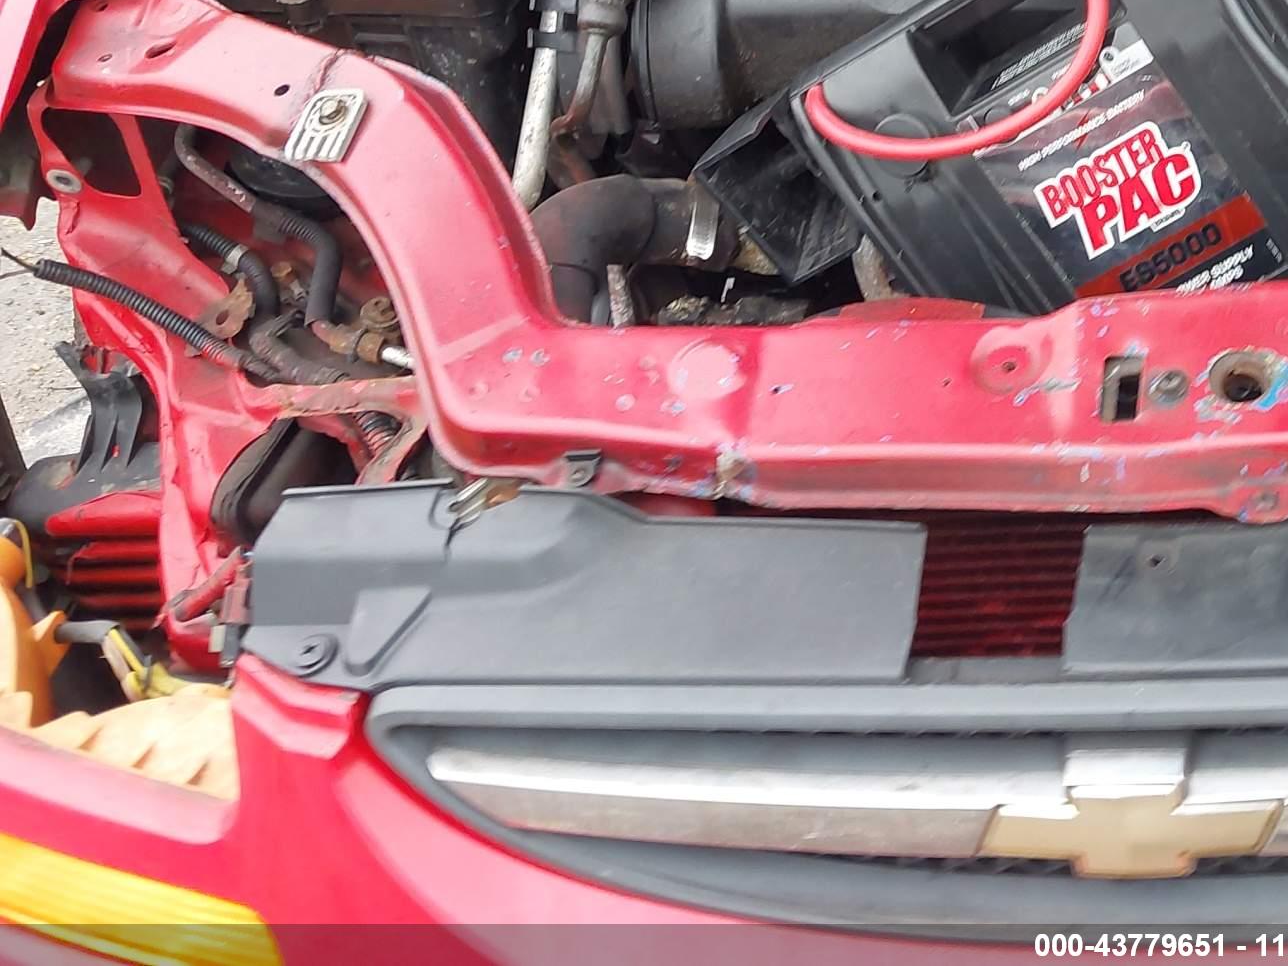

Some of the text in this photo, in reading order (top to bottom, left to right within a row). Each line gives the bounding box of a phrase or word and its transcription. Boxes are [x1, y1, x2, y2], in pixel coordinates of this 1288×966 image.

[1040, 128, 1166, 221] BOOSTER
[1082, 153, 1195, 252] PAC
[1119, 223, 1222, 292] ES5000
